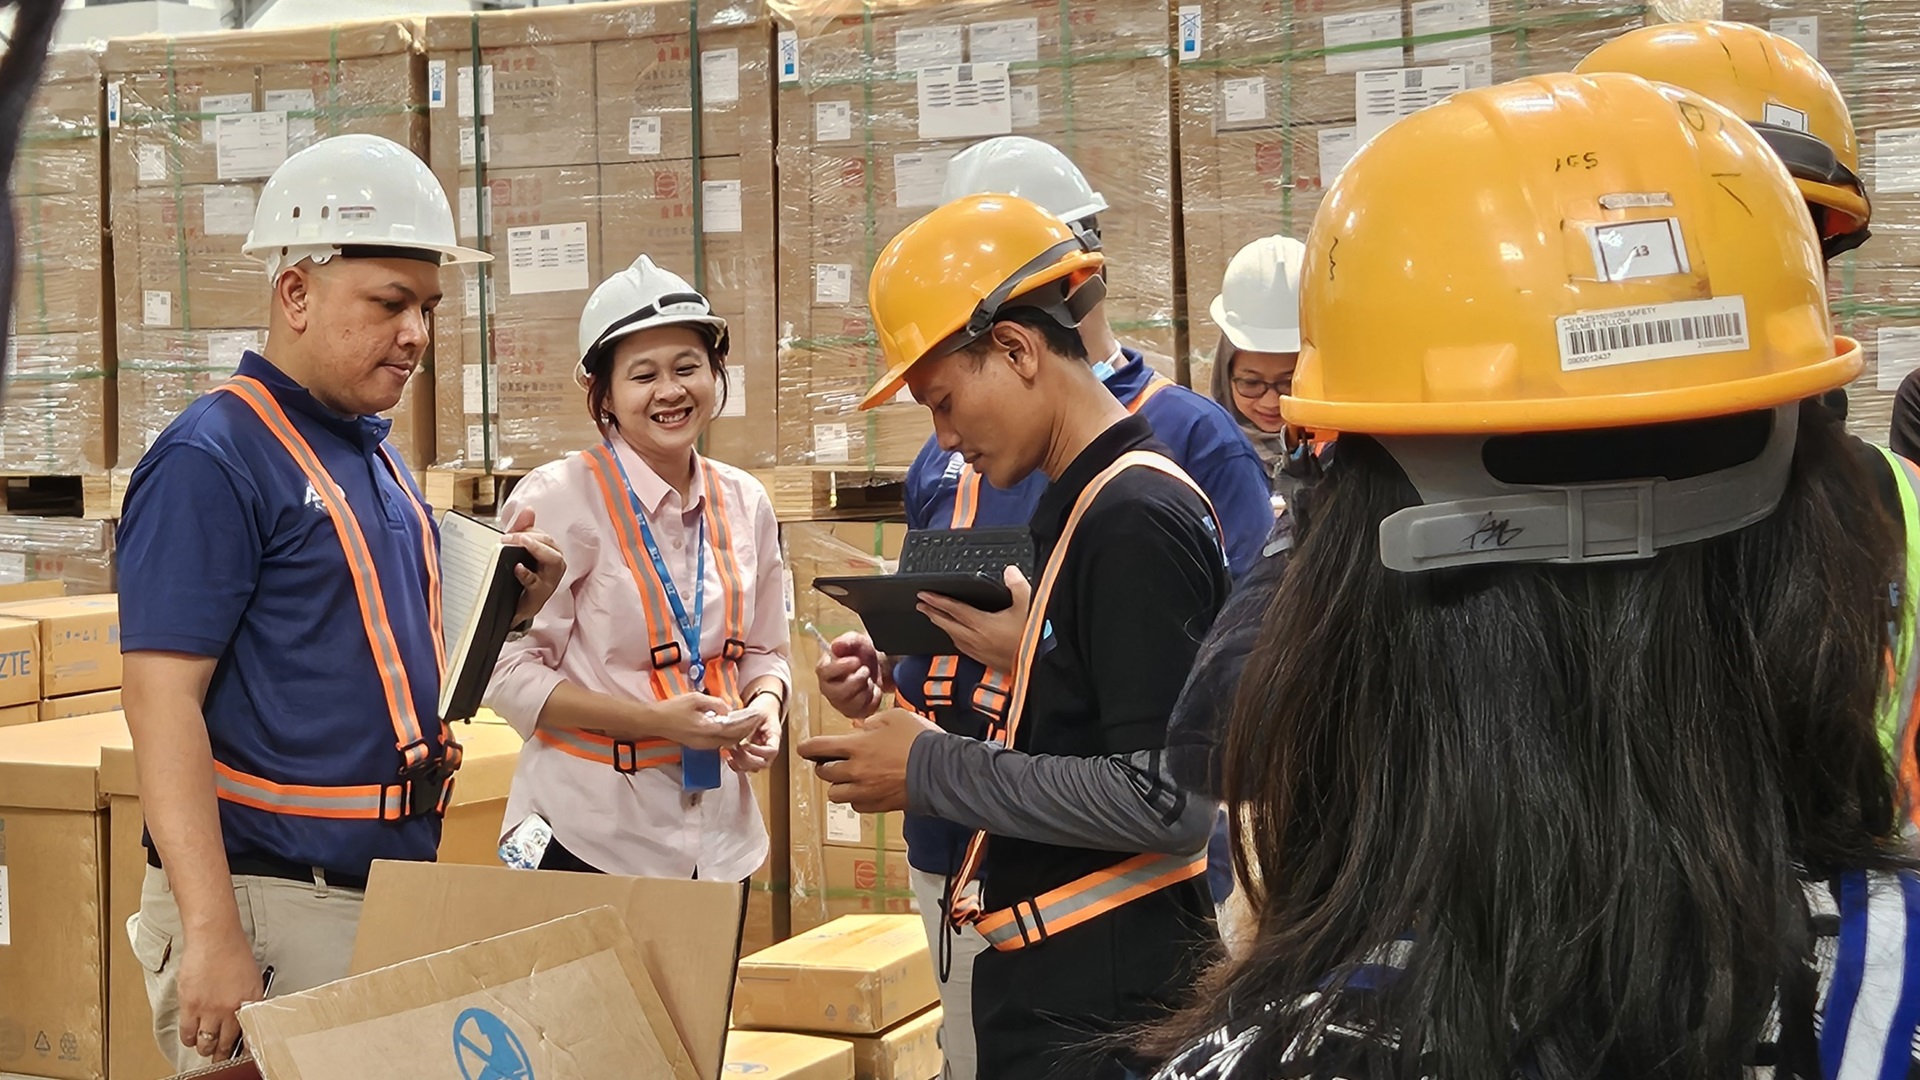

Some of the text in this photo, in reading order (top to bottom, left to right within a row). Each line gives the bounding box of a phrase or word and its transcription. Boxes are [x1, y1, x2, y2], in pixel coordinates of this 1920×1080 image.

[1627, 306, 1657, 317] SAFETY
[1565, 317, 1631, 331] HELMET YELLOW
[0, 650, 31, 679] ZTE
